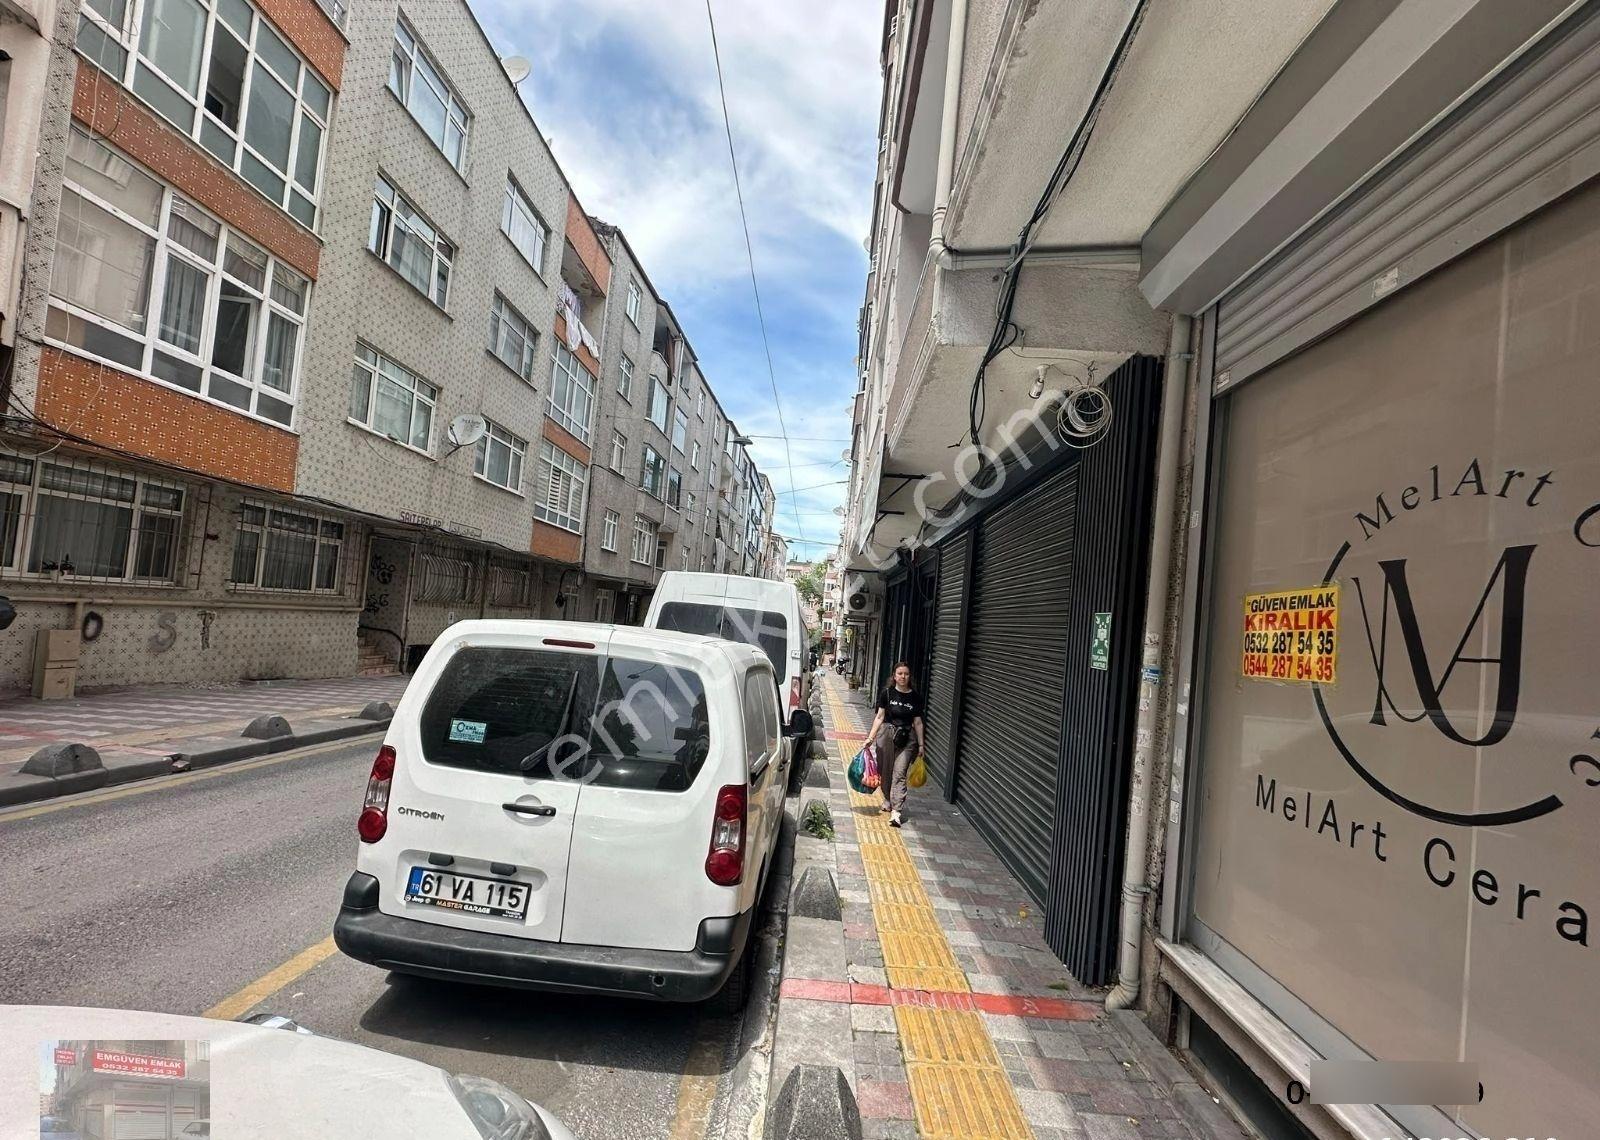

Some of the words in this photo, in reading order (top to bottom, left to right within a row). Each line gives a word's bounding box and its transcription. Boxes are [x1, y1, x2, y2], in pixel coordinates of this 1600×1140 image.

[1353, 458, 1554, 541] MelArt
[1251, 596, 1288, 613] GÜVEN
[1289, 593, 1335, 610] EMLAK
[1244, 632, 1269, 654] 0532
[1272, 631, 1293, 654] 287
[1297, 630, 1313, 655] 54
[1317, 630, 1334, 655] 35
[1243, 654, 1268, 676] 0544
[1271, 655, 1293, 678] 287
[1296, 656, 1312, 680] 54
[1316, 656, 1333, 681] 35
[1255, 774, 1388, 862] MelArt
[1423, 837, 1589, 948] Cera
[420, 873, 443, 897] 61
[452, 877, 474, 902] VA
[487, 883, 523, 909] 115
[436, 900, 464, 910] MASTER
[463, 904, 491, 914] GARAGE
